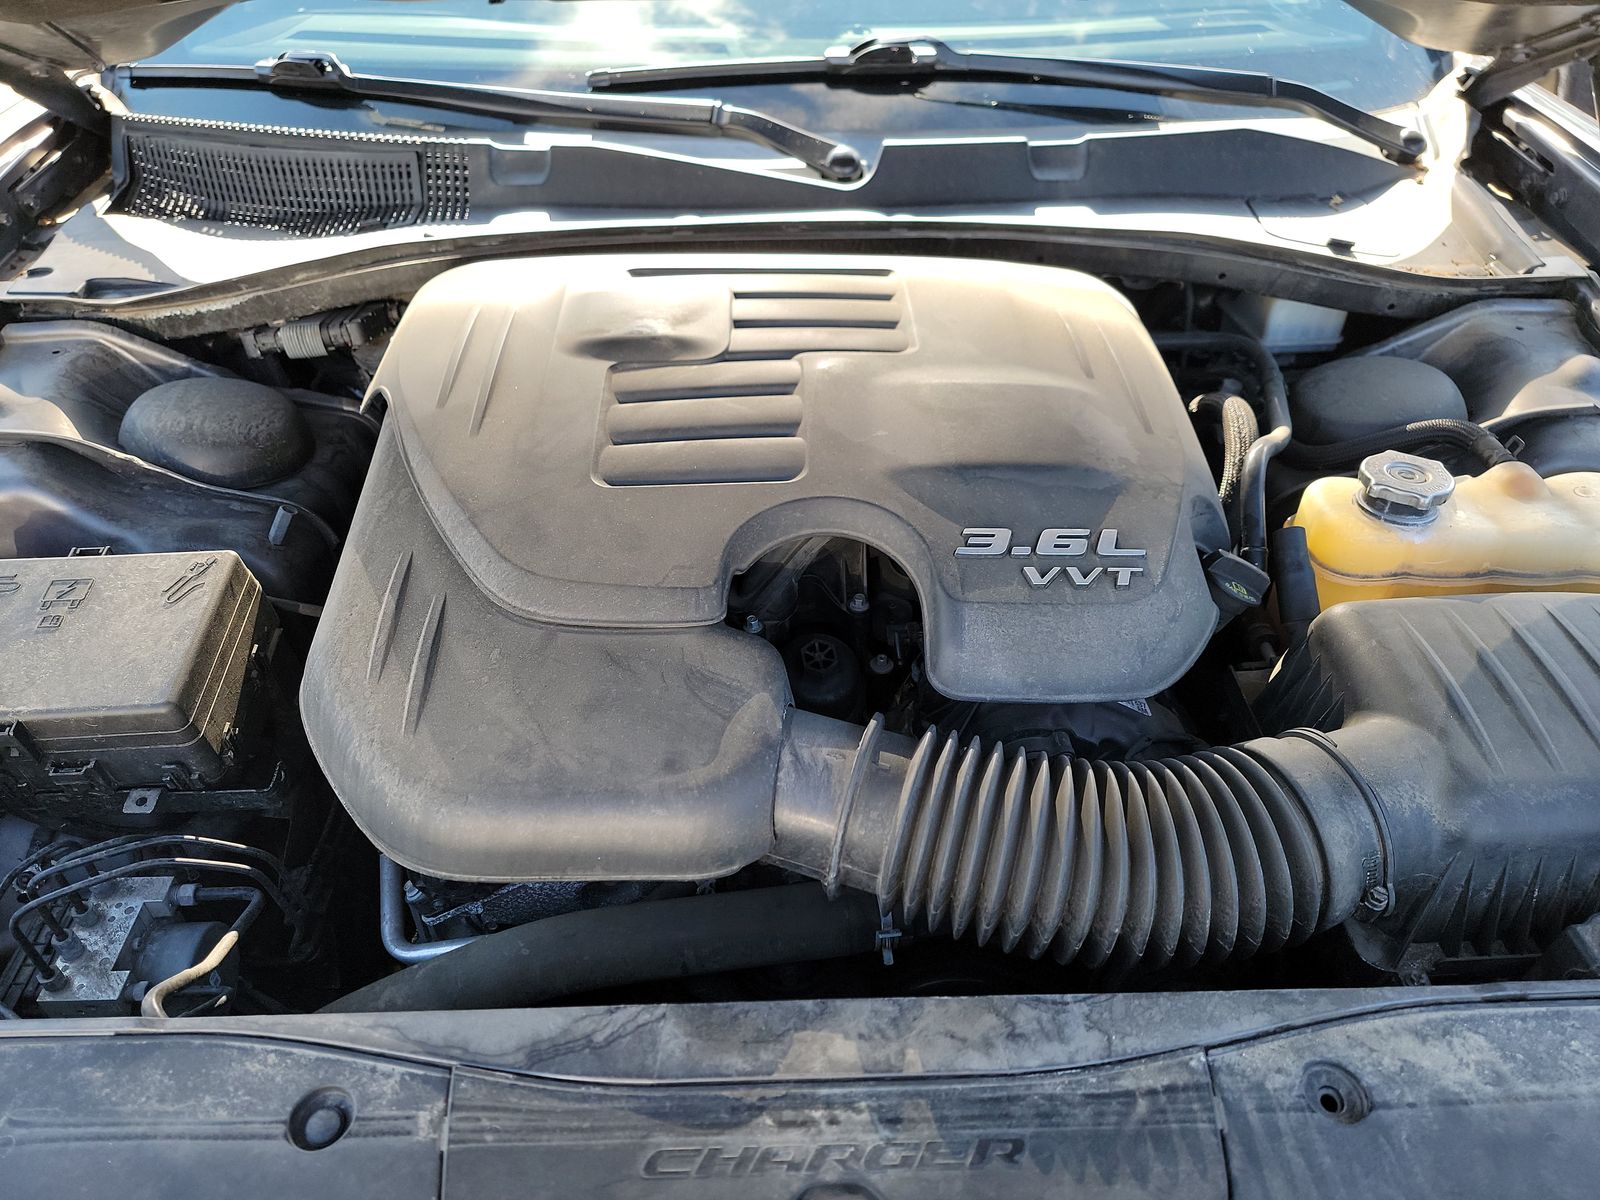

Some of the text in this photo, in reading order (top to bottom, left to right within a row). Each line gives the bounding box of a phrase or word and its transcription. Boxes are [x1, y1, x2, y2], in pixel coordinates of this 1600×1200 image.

[954, 527, 1147, 558] 3.6L
[1022, 566, 1145, 589] VVT
[642, 1138, 1025, 1179] CHARGER
